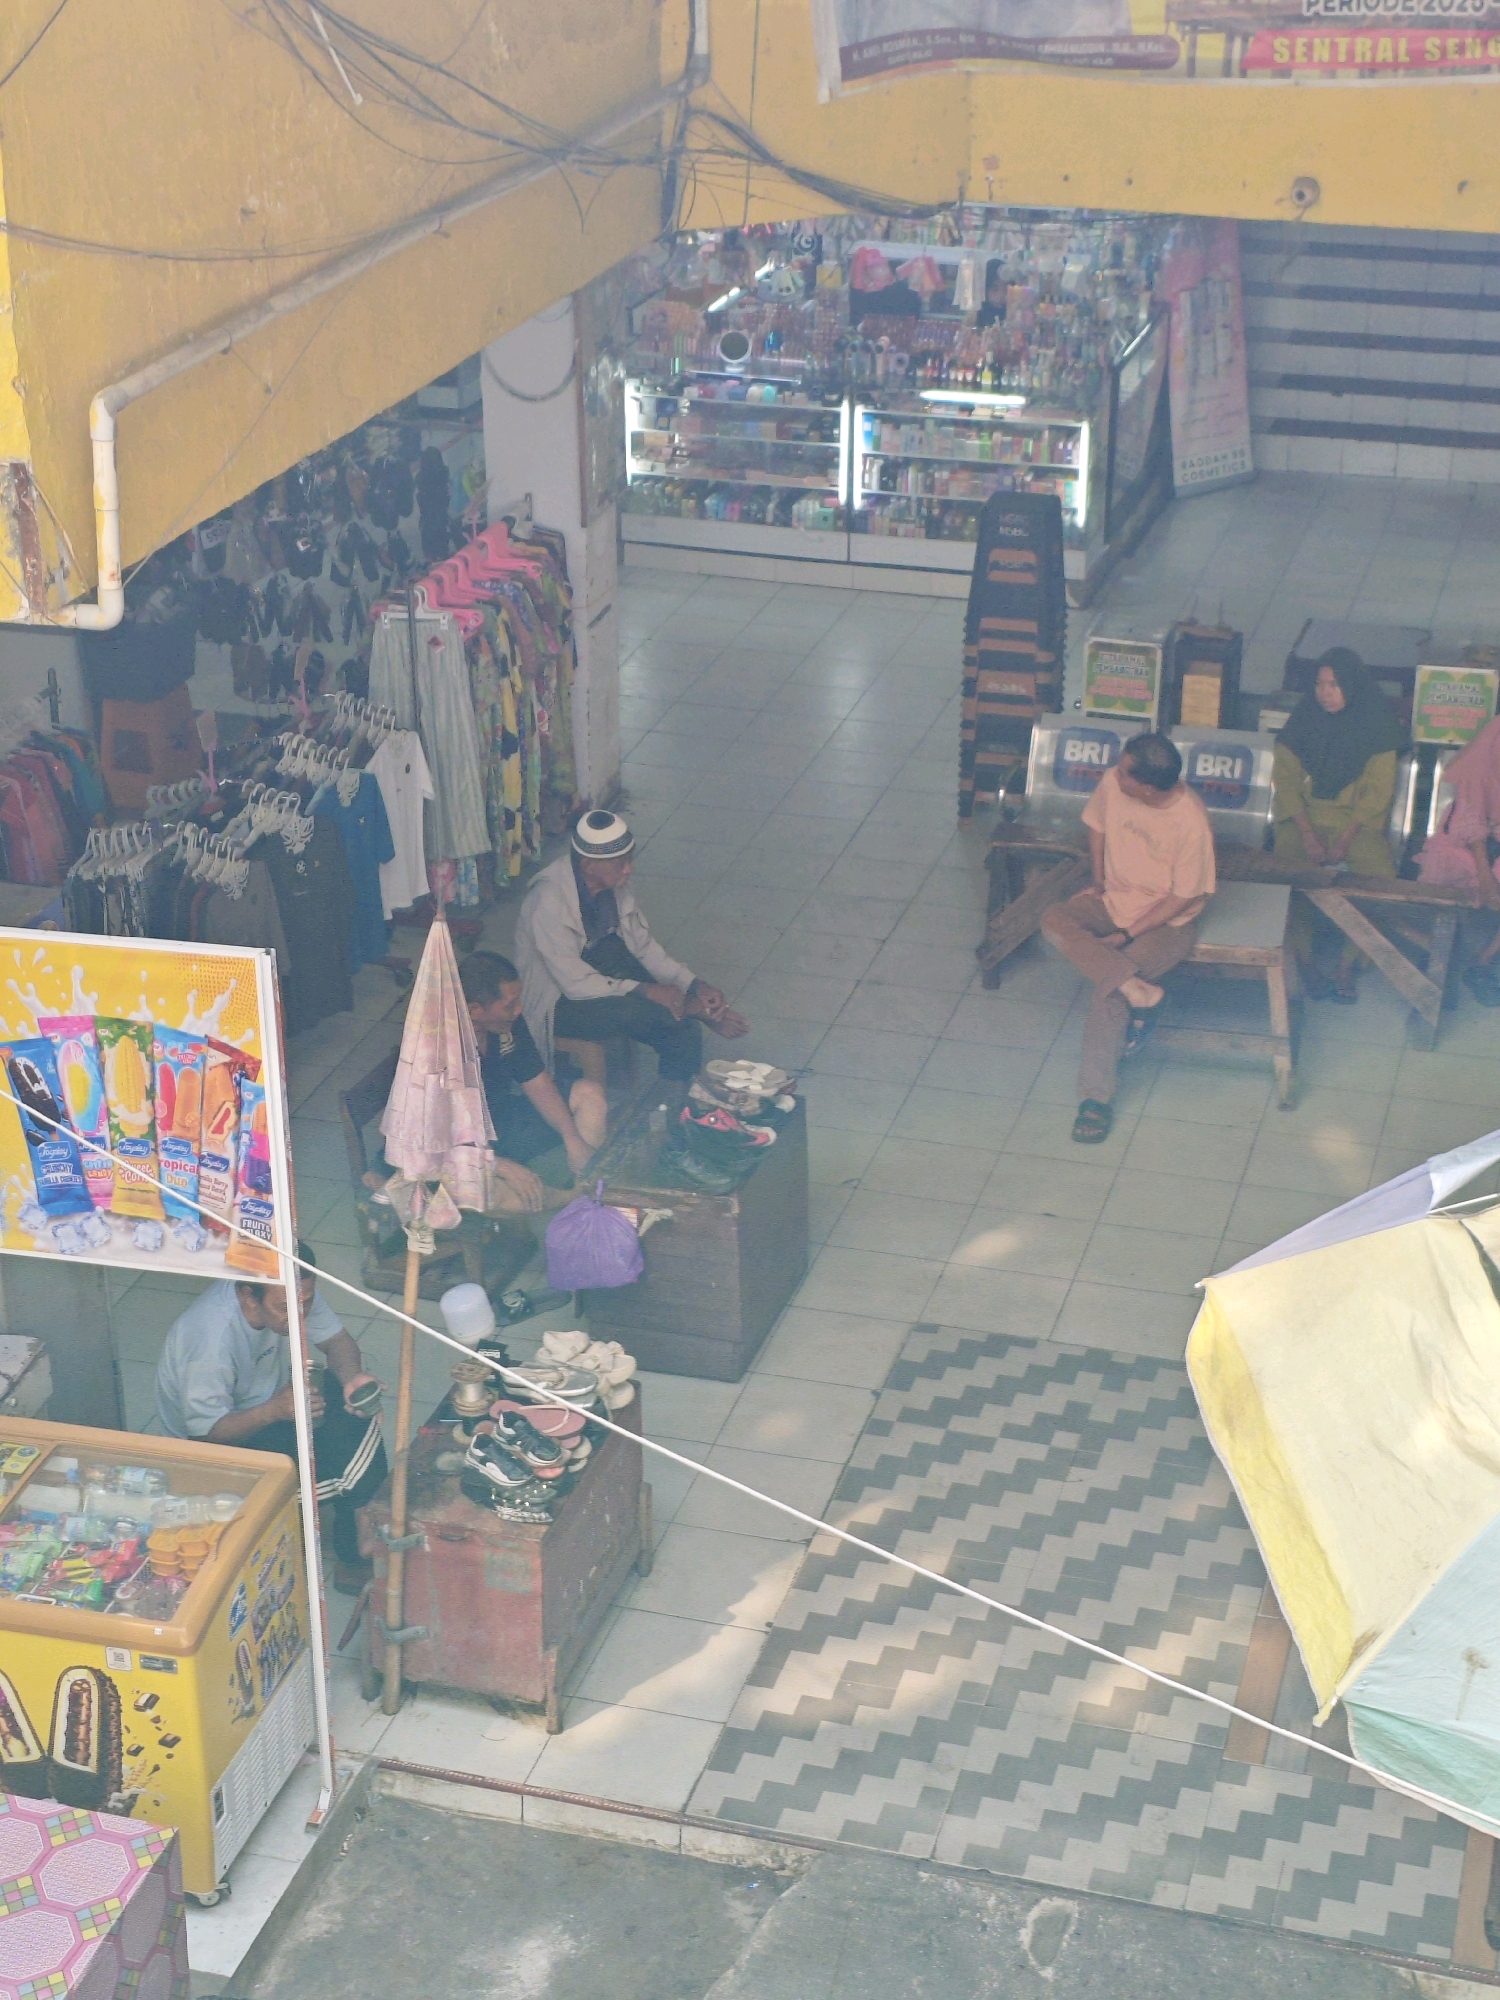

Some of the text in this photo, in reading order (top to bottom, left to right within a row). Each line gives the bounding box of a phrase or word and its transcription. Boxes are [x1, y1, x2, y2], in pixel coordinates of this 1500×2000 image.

[1304, 0, 1416, 14] PERIODE
[1273, 36, 1411, 64] SENTRAL
[1063, 739, 1111, 765] BRI
[1195, 753, 1243, 780] BRI
[39, 1145, 69, 1159] Joyday
[120, 1141, 149, 1156] Joyday
